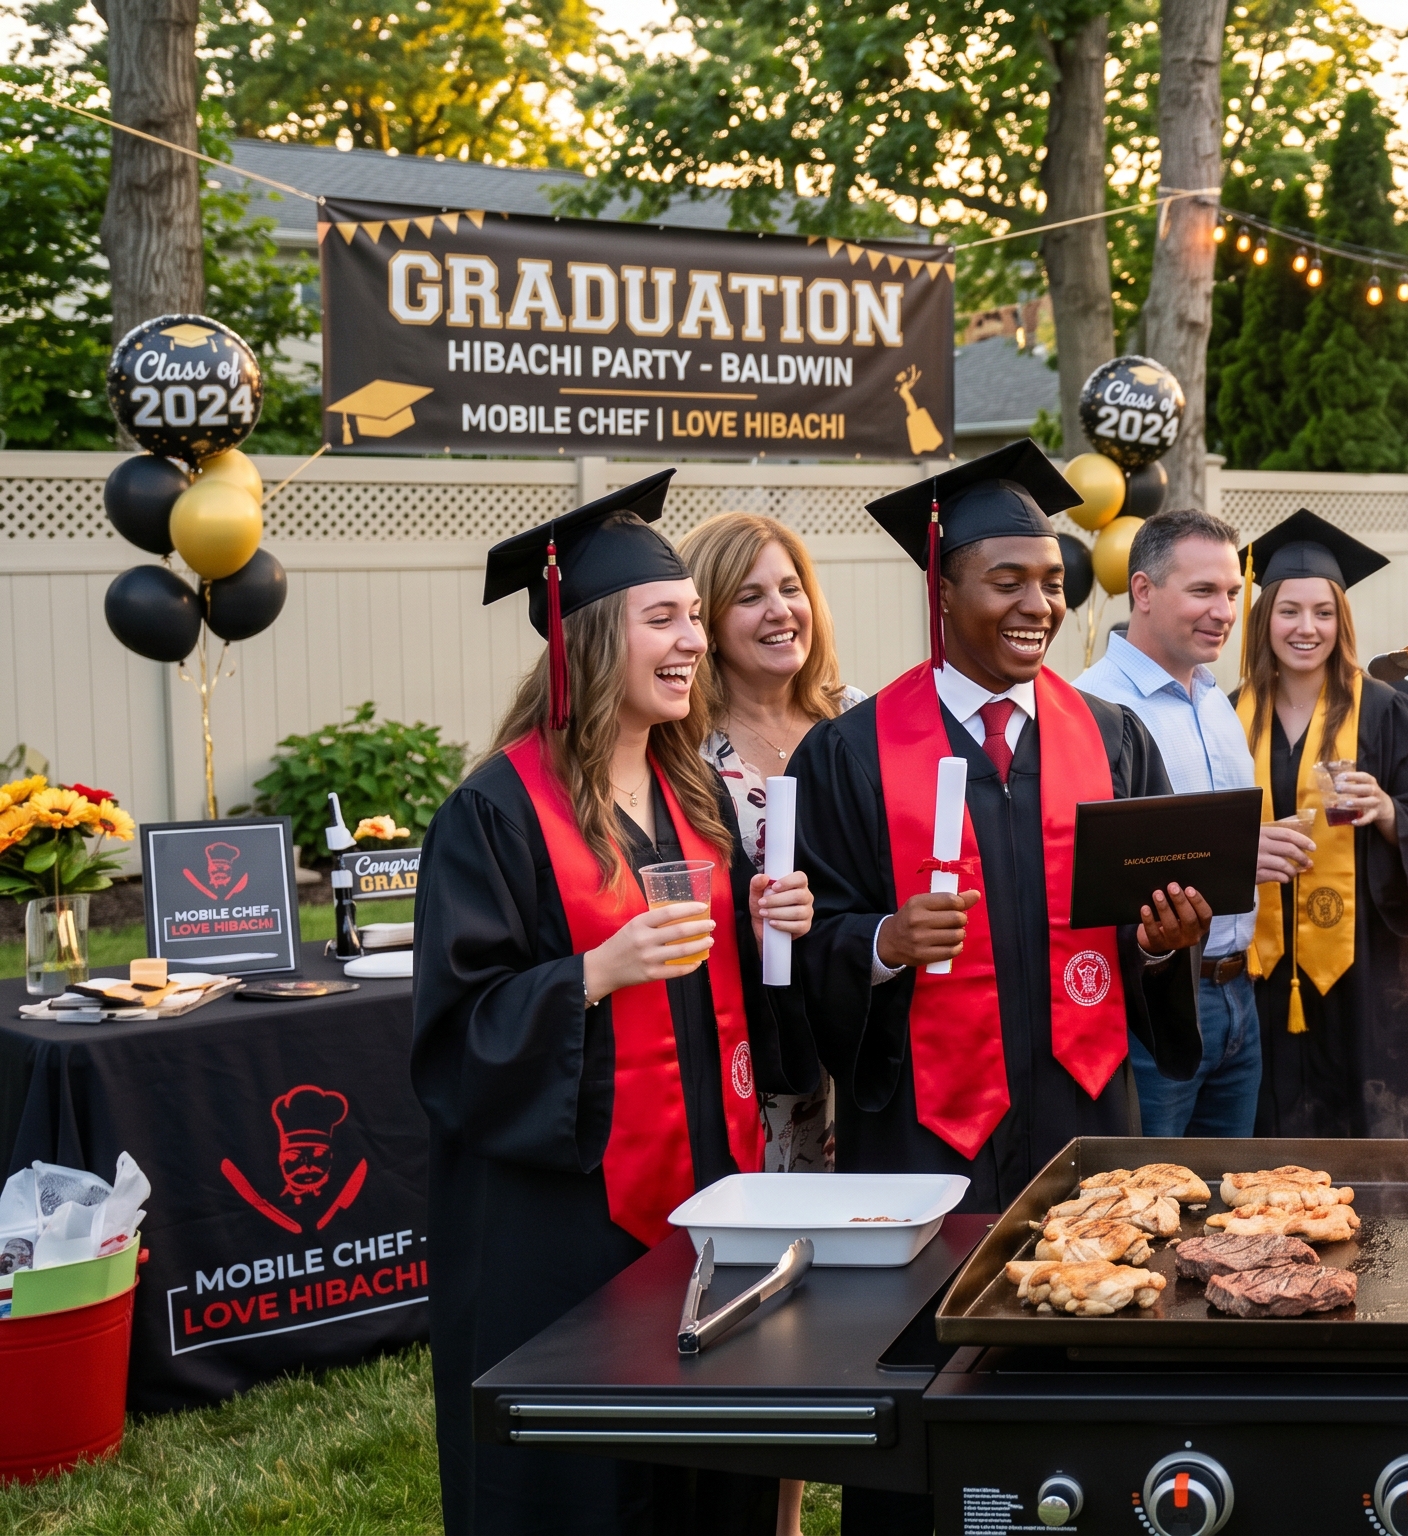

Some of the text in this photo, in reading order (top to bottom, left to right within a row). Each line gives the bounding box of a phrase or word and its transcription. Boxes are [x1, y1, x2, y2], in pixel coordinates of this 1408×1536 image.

[388, 249, 904, 347] GRADUATION
[134, 350, 241, 389] Class of
[448, 339, 582, 377] HIBACHI
[592, 345, 692, 381] PARTY
[720, 351, 853, 387] BALDWIN
[129, 383, 255, 428] 2024
[1103, 380, 1177, 420] Class of
[462, 403, 572, 435] MOBILE
[577, 406, 650, 436] CHEF
[671, 410, 738, 438] LOVE
[744, 411, 845, 440] HIBACHI
[1094, 405, 1180, 447] 2024
[171, 922, 211, 936] LOVE
[174, 904, 270, 922] MOBILE CHEF
[195, 1228, 413, 1296] MOBILE CHEF
[183, 1259, 429, 1336] LOVE HIBACHI
